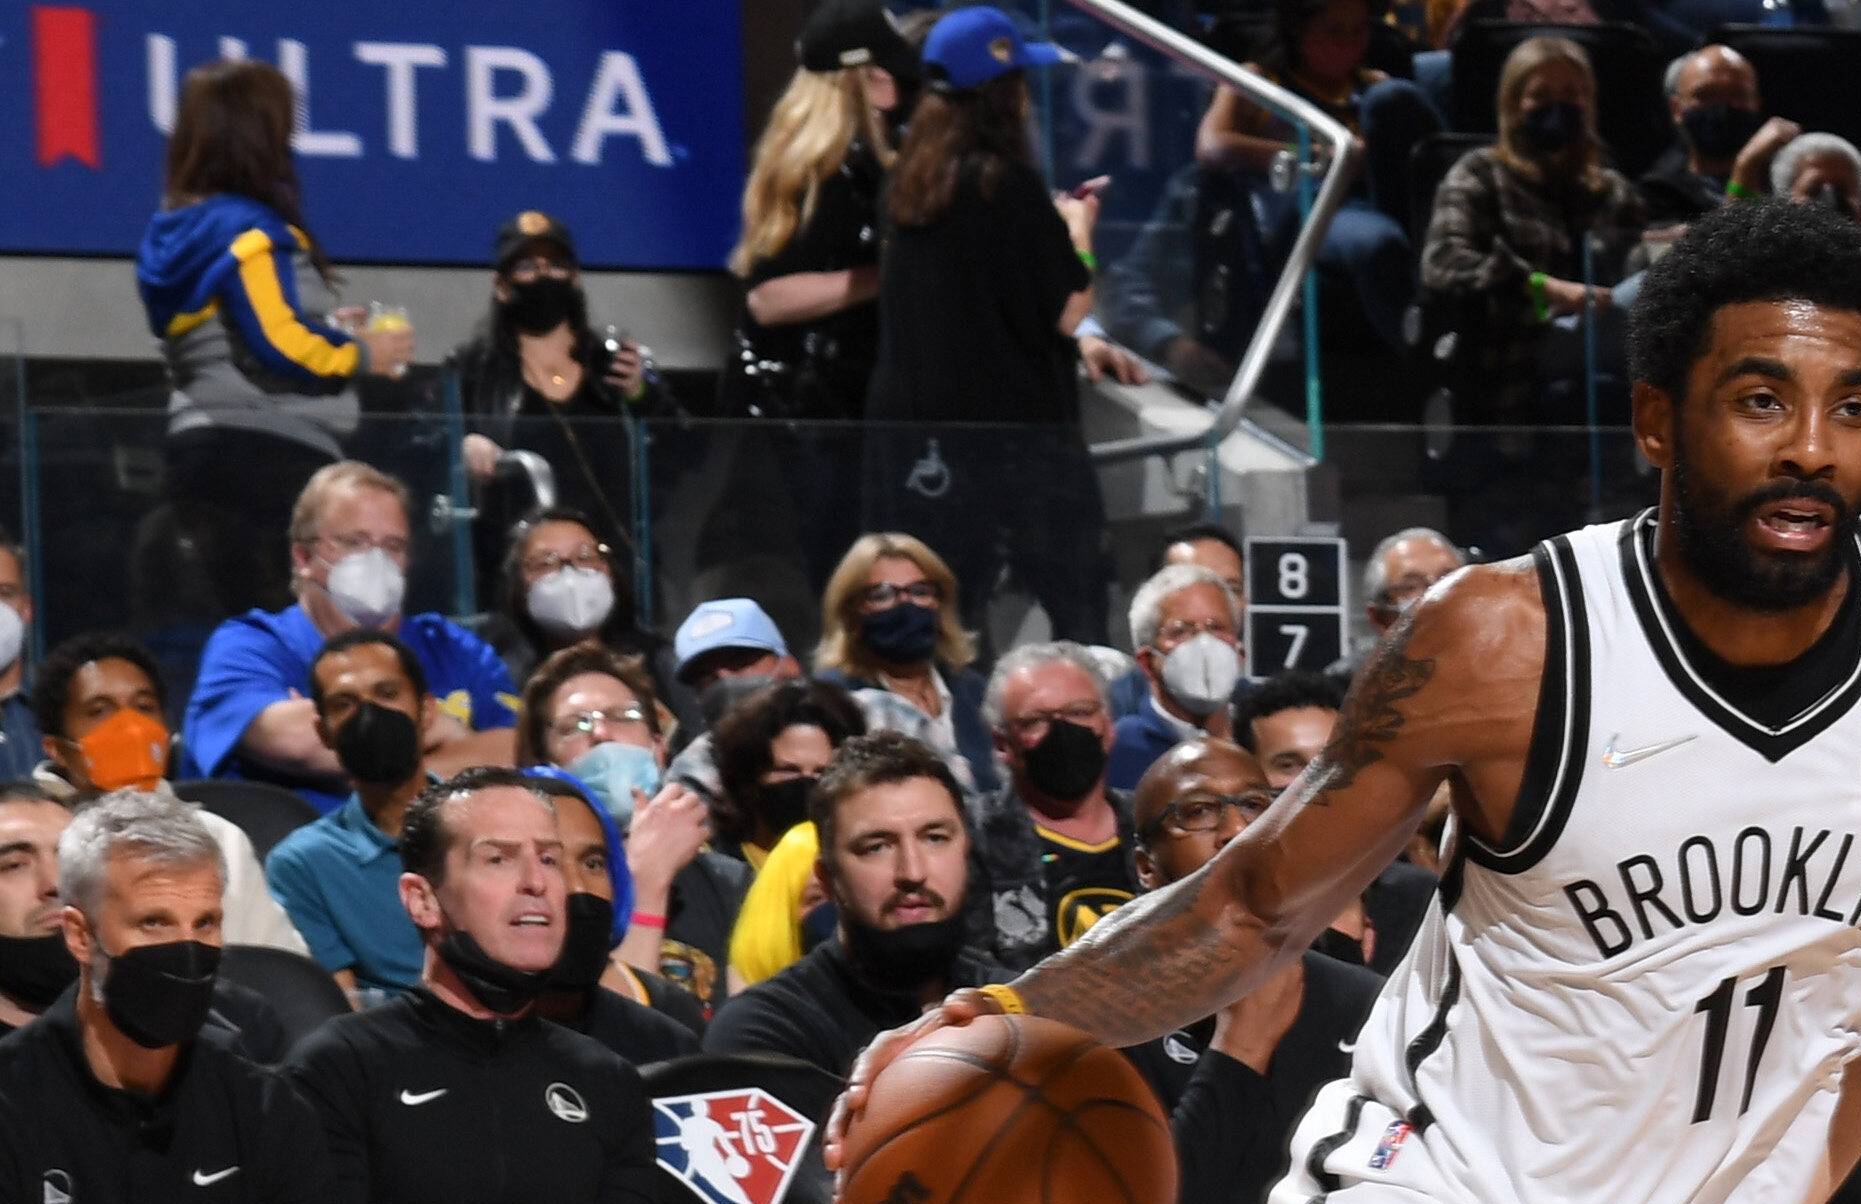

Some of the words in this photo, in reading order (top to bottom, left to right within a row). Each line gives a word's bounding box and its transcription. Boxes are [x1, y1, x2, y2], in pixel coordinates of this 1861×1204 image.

[146, 33, 675, 167] ULTRA
[1278, 552, 1309, 599] 8
[1278, 623, 1309, 670] 7
[1690, 965, 1787, 1125] 11
[730, 1109, 776, 1156] 75
